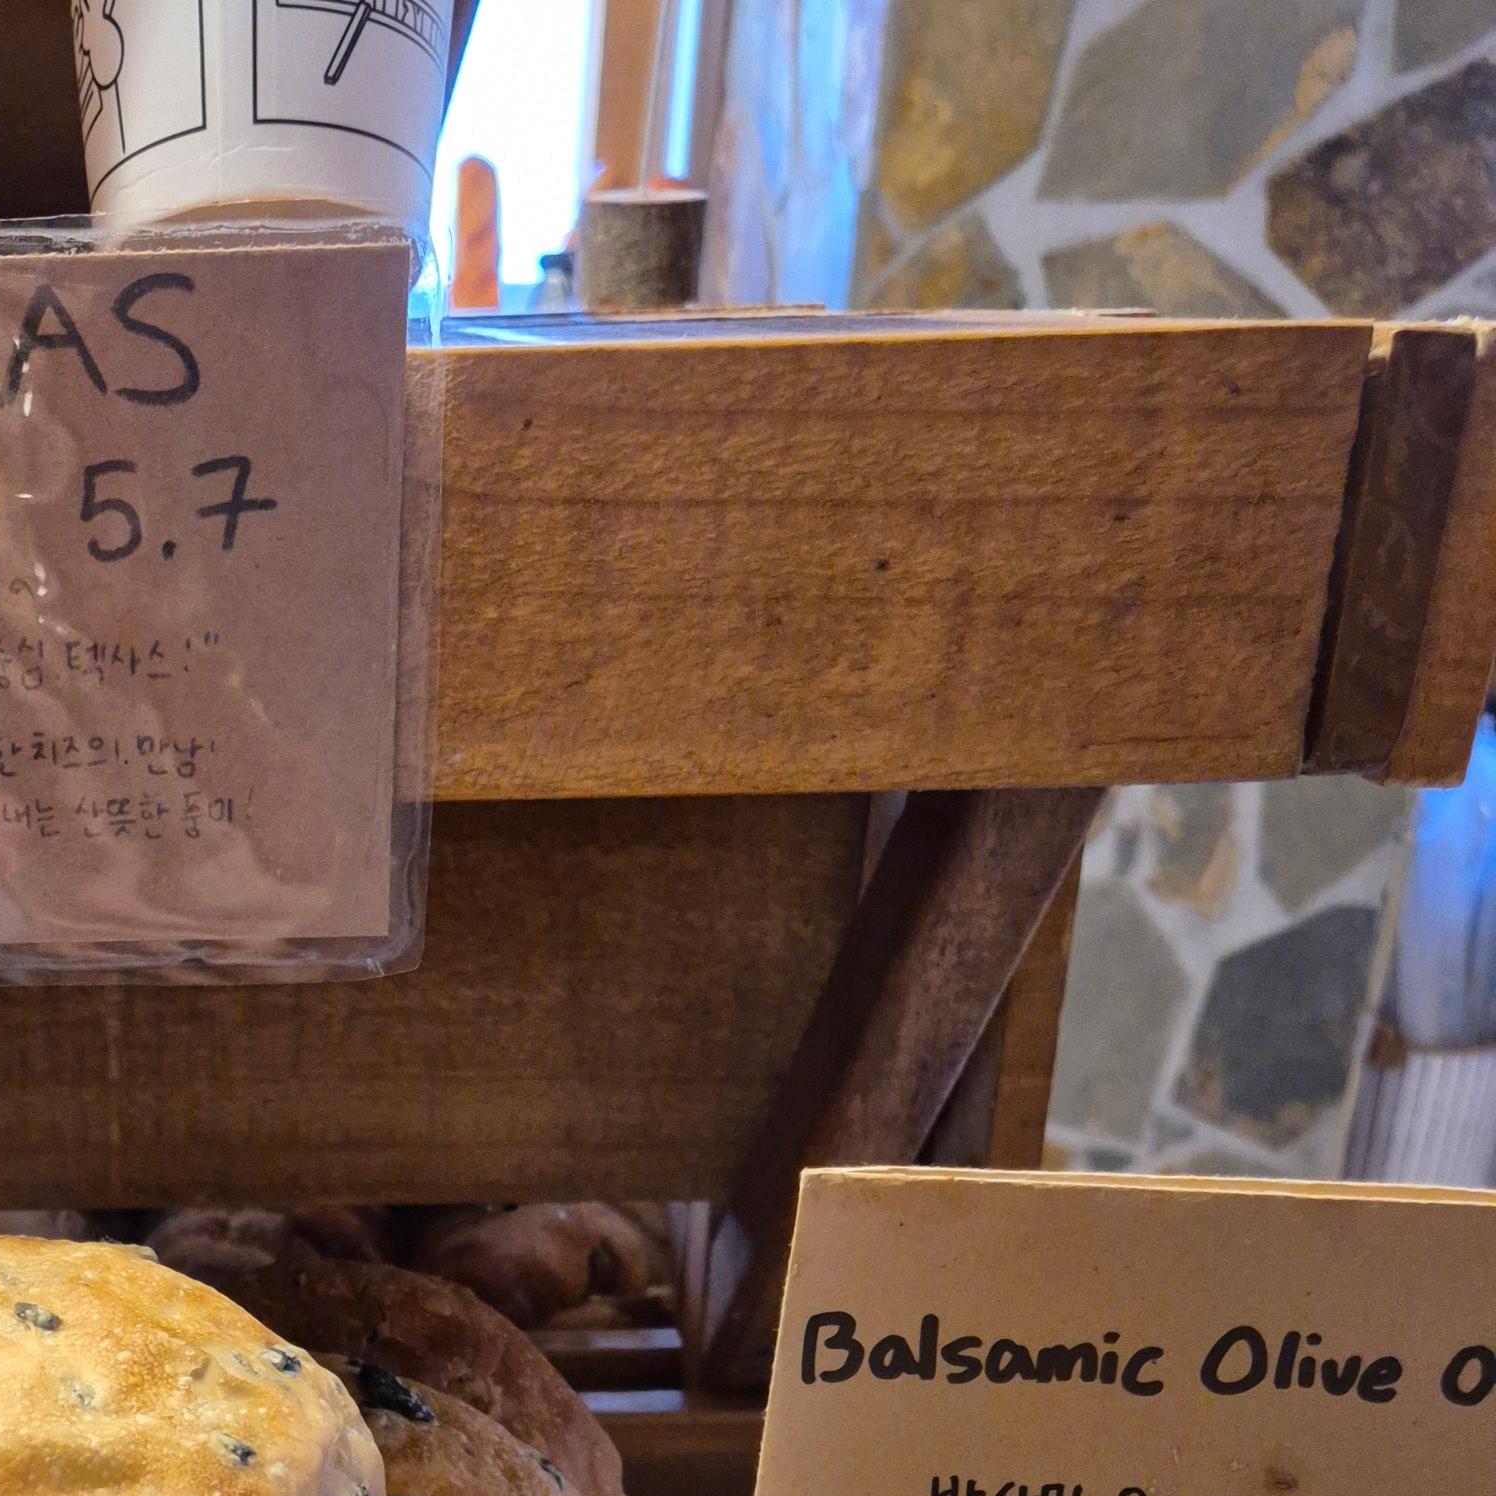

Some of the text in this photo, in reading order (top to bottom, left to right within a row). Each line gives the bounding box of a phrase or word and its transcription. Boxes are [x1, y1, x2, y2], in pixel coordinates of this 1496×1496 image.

[80, 455, 278, 563] 5.7
[75, 791, 168, 839] 산뜻한
[801, 1311, 1166, 1398] Balsamic
[1201, 1325, 1405, 1403] Olive
